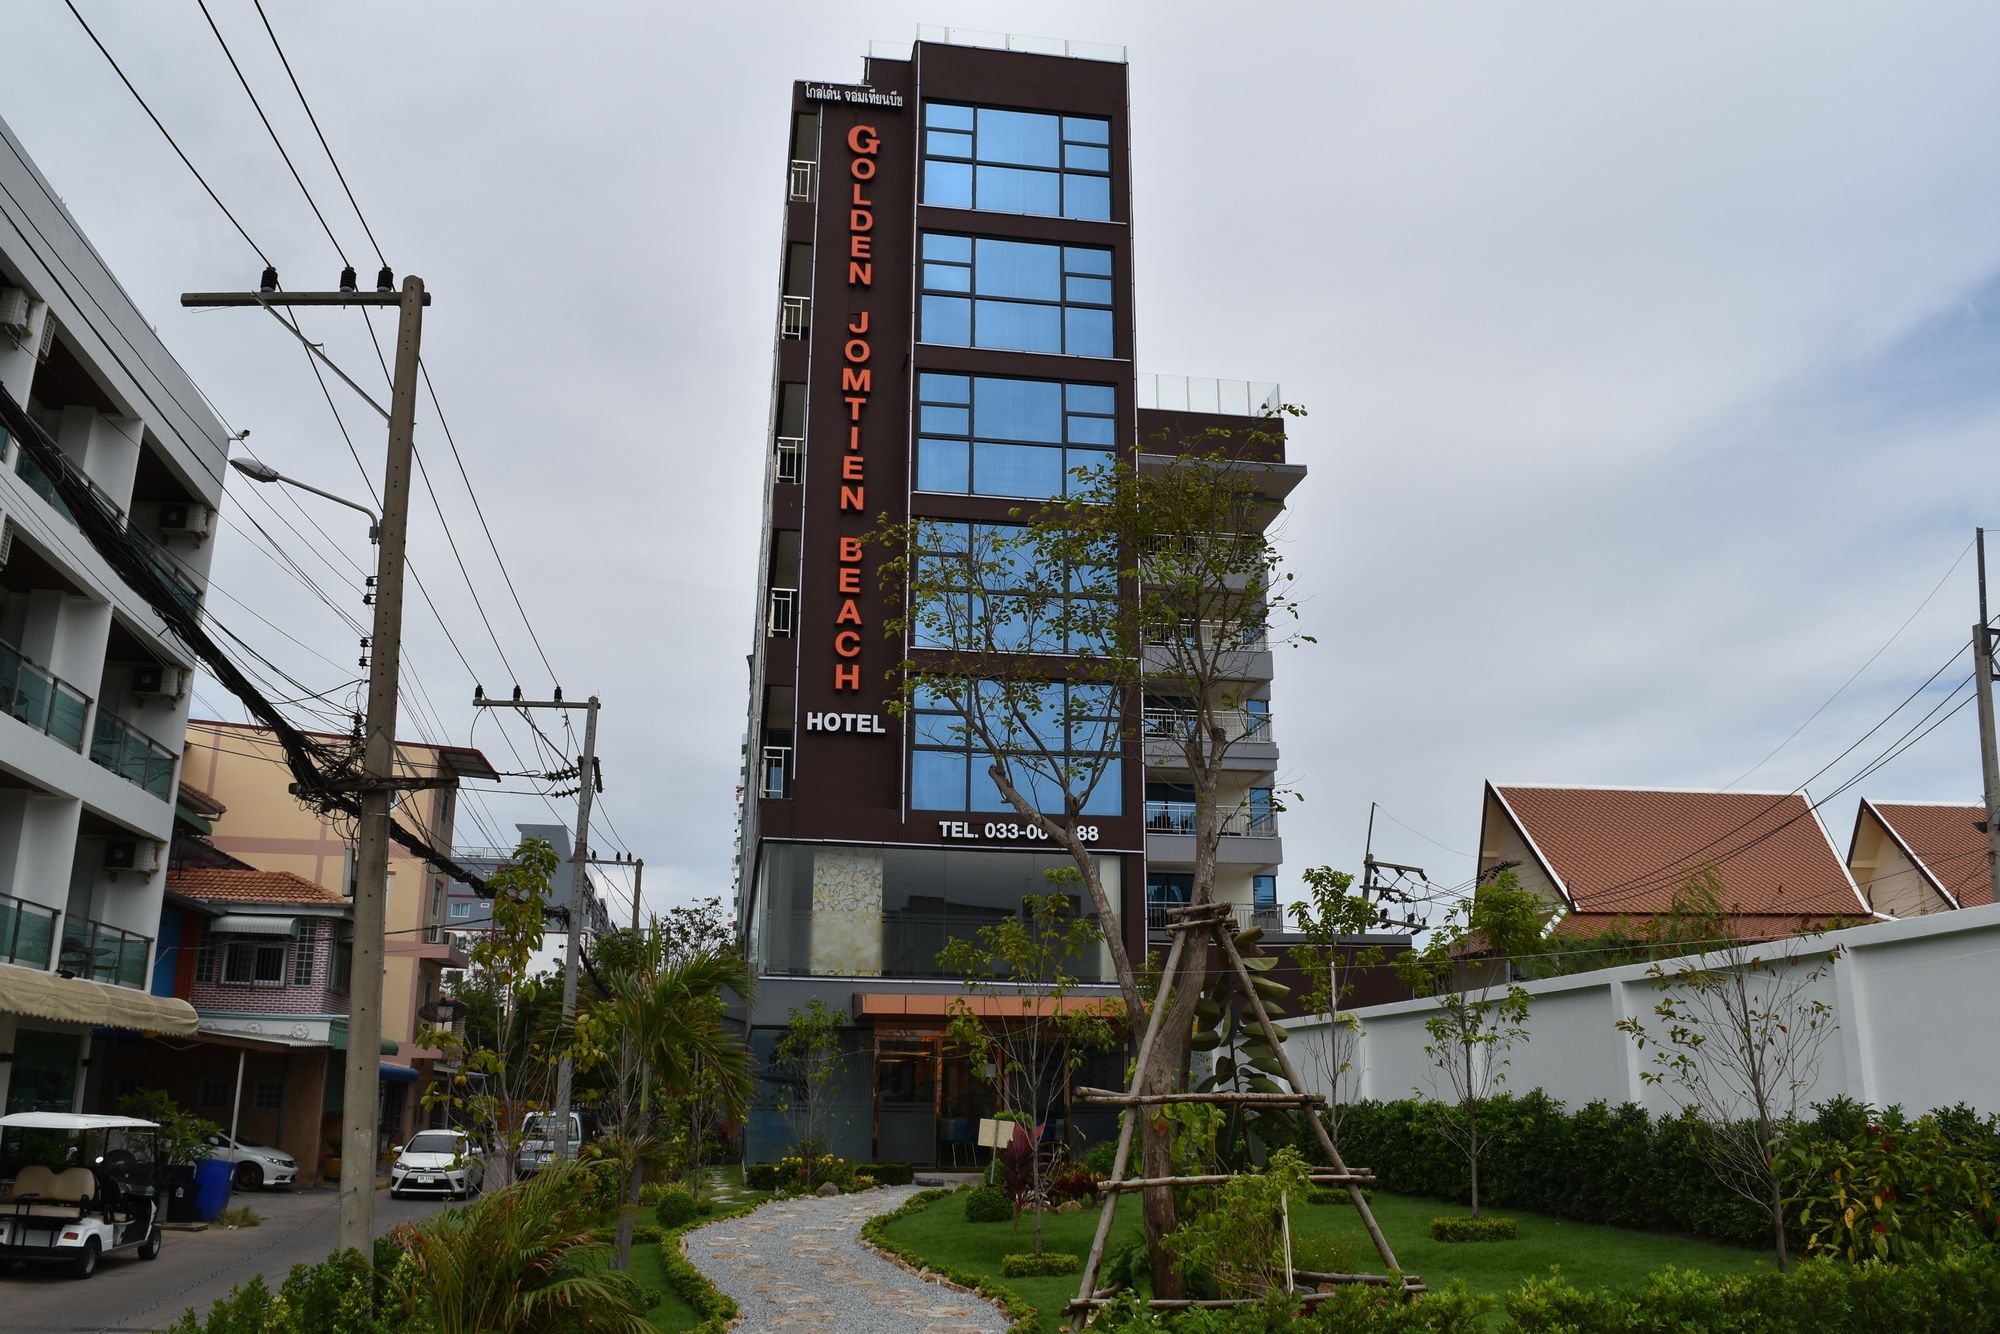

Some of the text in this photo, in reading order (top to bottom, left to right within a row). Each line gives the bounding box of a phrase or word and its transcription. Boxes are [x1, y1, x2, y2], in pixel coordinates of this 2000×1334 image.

[834, 125, 881, 690] GOLDEN JOMTIEN BEACH
[806, 711, 886, 734] HOTEL
[938, 821, 979, 838] TEL.
